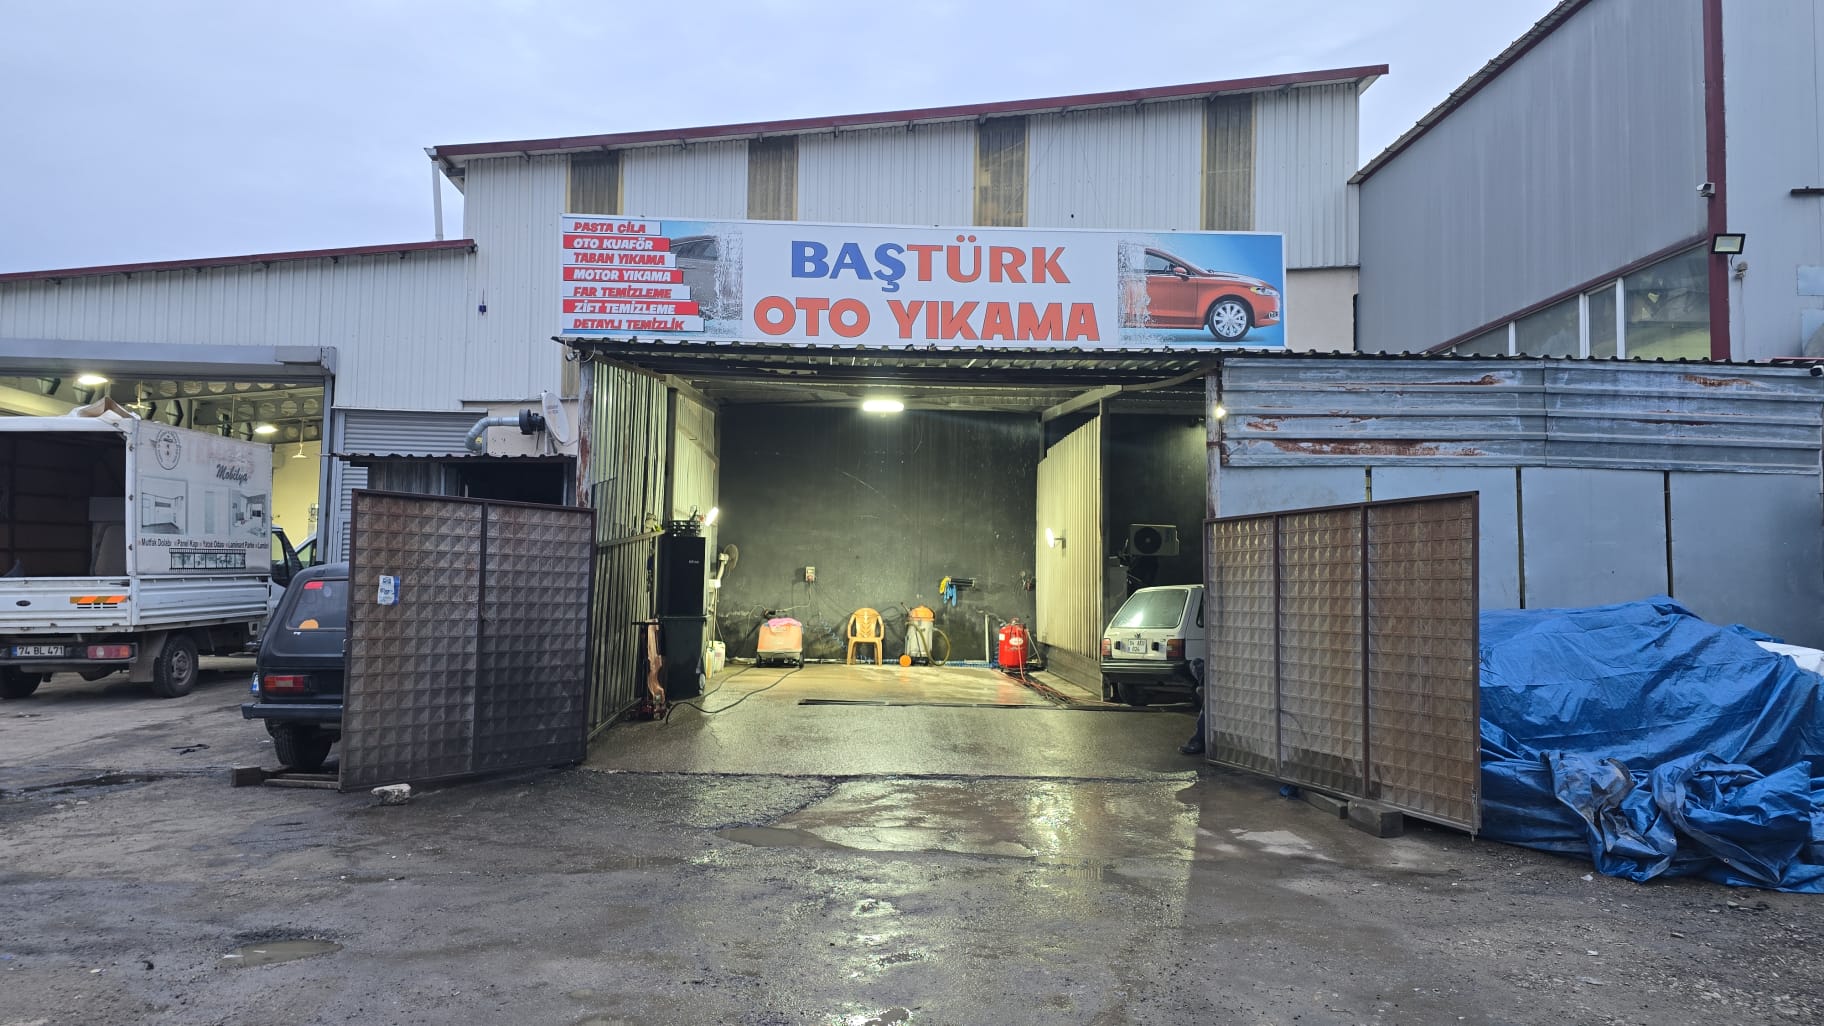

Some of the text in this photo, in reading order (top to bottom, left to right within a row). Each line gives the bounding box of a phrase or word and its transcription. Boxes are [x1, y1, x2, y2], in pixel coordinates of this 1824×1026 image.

[573, 221, 646, 234] PASTA CİLA
[573, 237, 653, 250] OTO KUAFÖR
[573, 252, 665, 266] TABAN YIKAMA
[791, 234, 1071, 293] BAŞTÜRK
[573, 269, 671, 282] MOTOR YIKAMA
[573, 285, 672, 298] FAR TEMİZLEME
[574, 300, 676, 315] ZİFT TEMİZLEME
[573, 317, 684, 331] DETAYLI TEMİZLİK
[753, 295, 1100, 341] OTO YIKAMA
[216, 463, 248, 486] Mobilya
[18, 646, 63, 655] 74 BL 471
